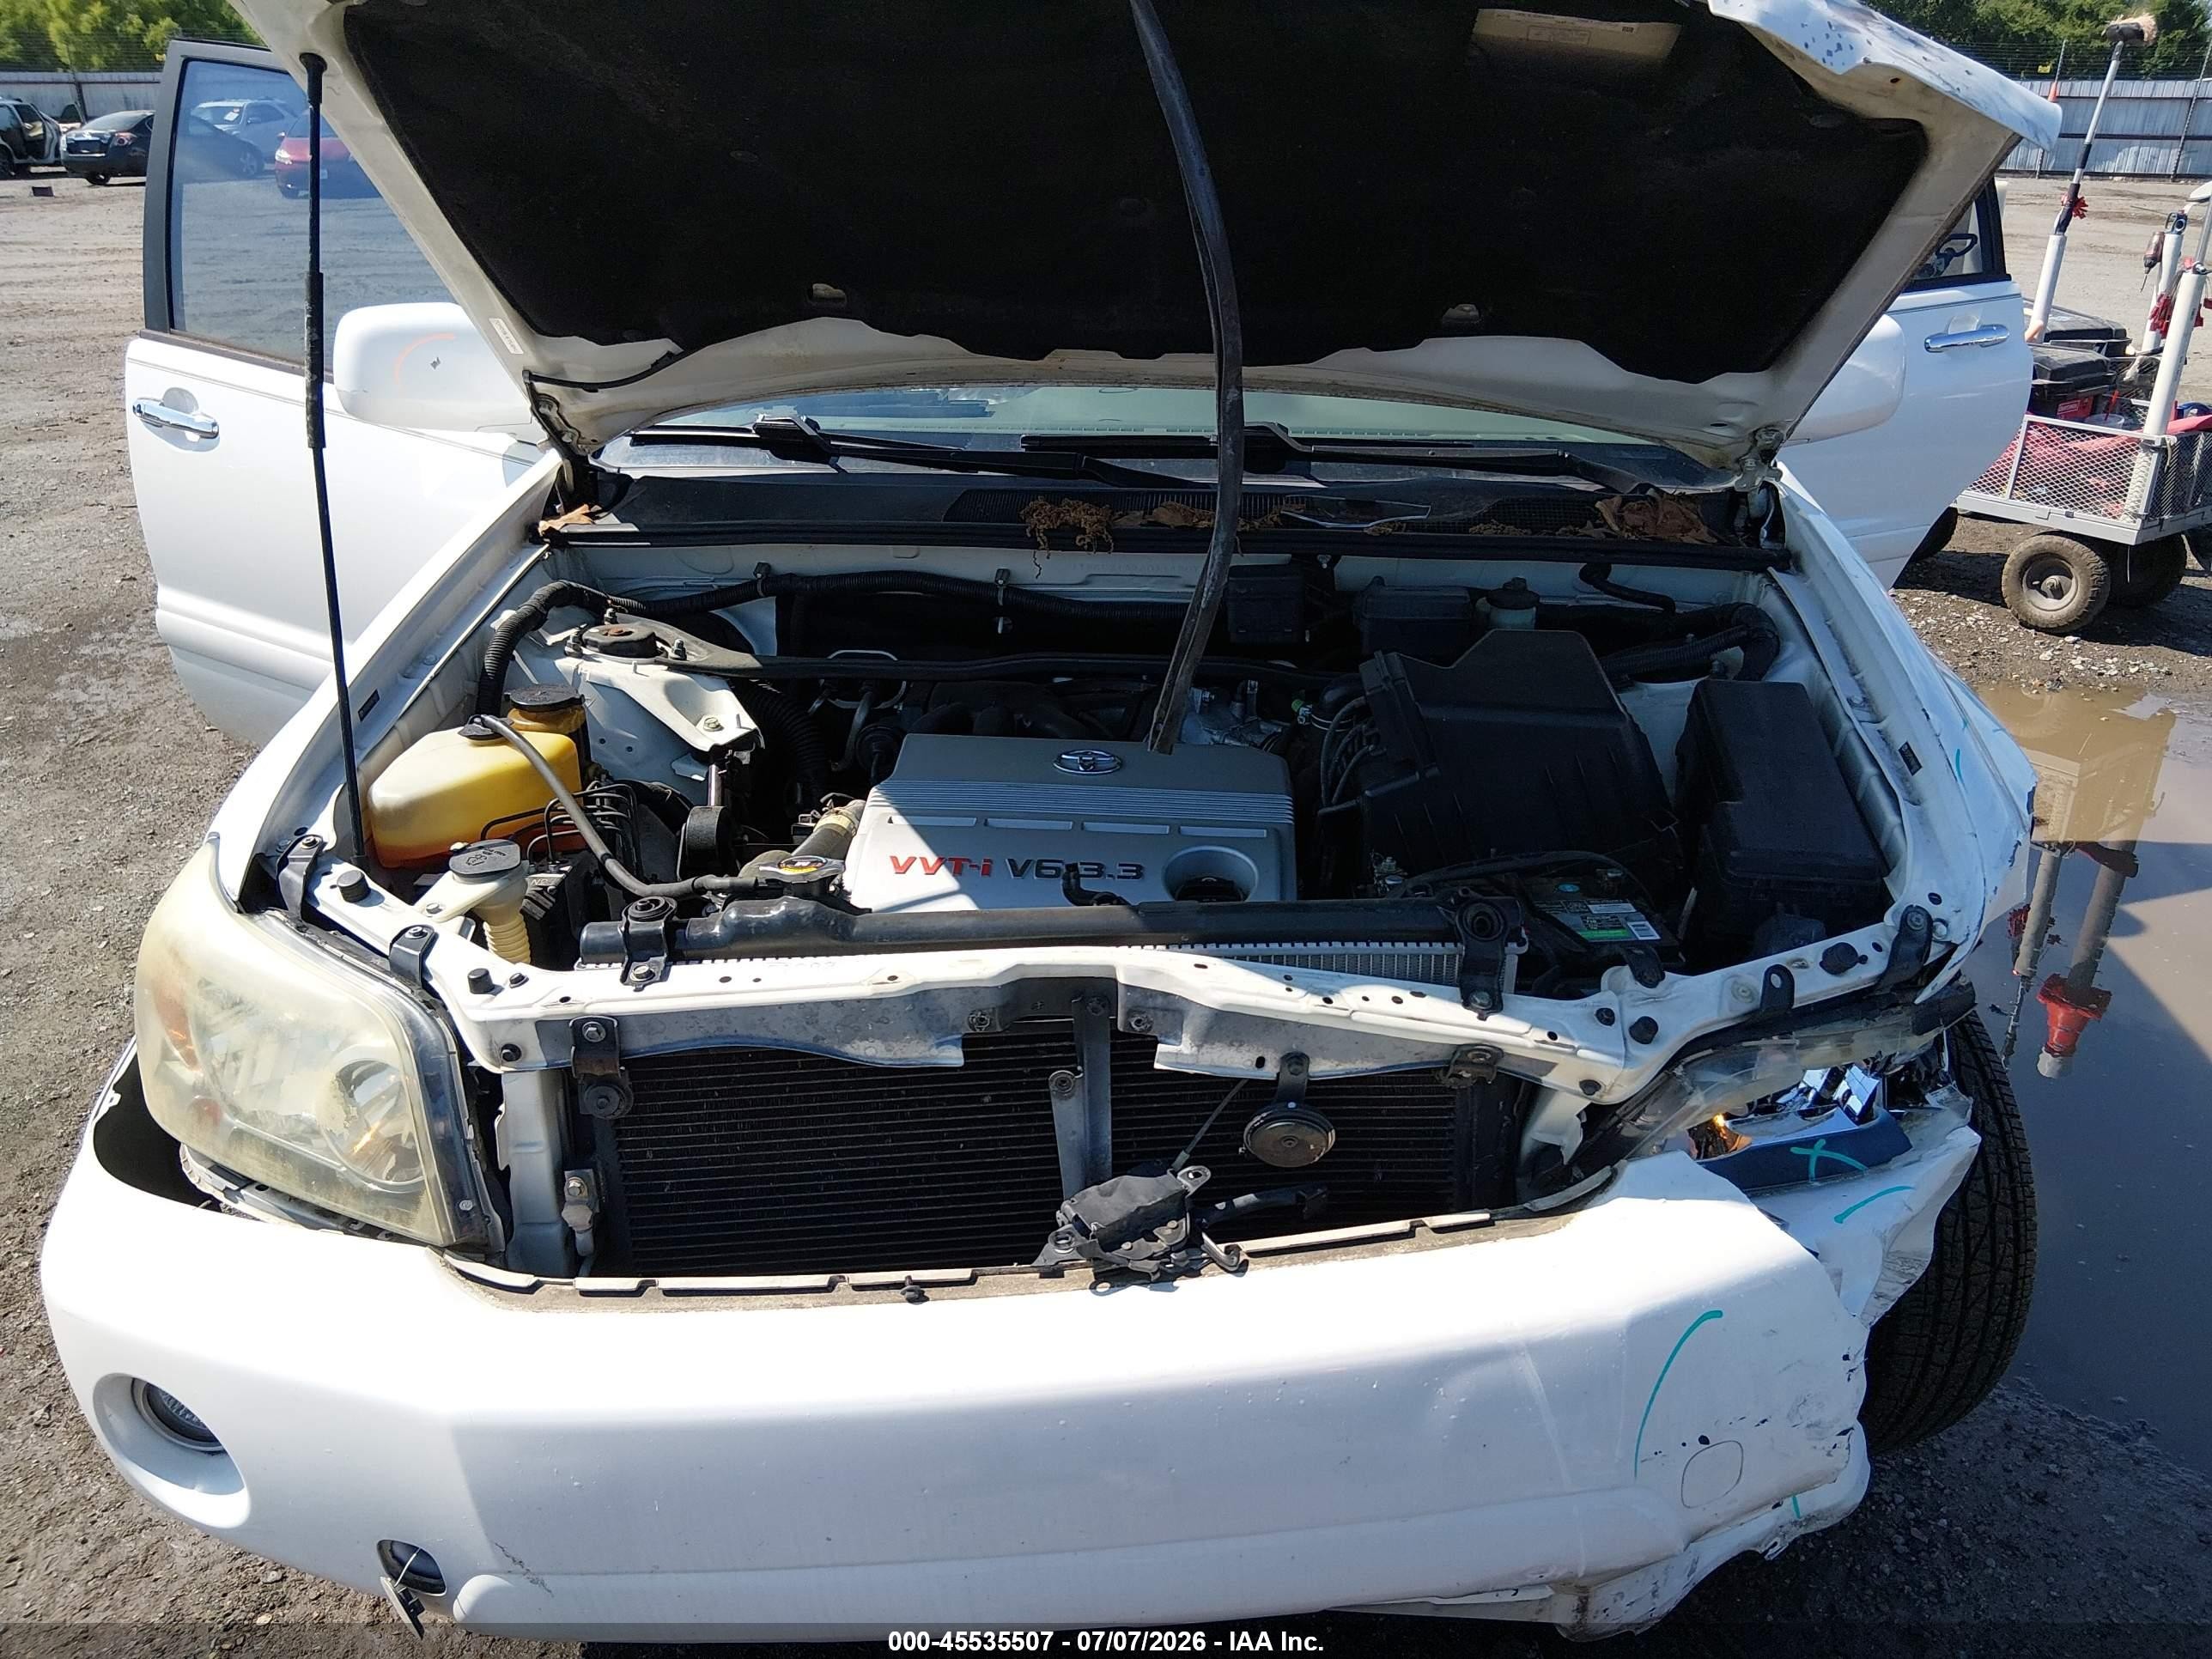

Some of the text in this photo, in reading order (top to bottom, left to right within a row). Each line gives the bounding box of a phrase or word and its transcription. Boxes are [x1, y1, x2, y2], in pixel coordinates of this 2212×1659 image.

[889, 855, 1146, 881] VVT-i V6 3.3
